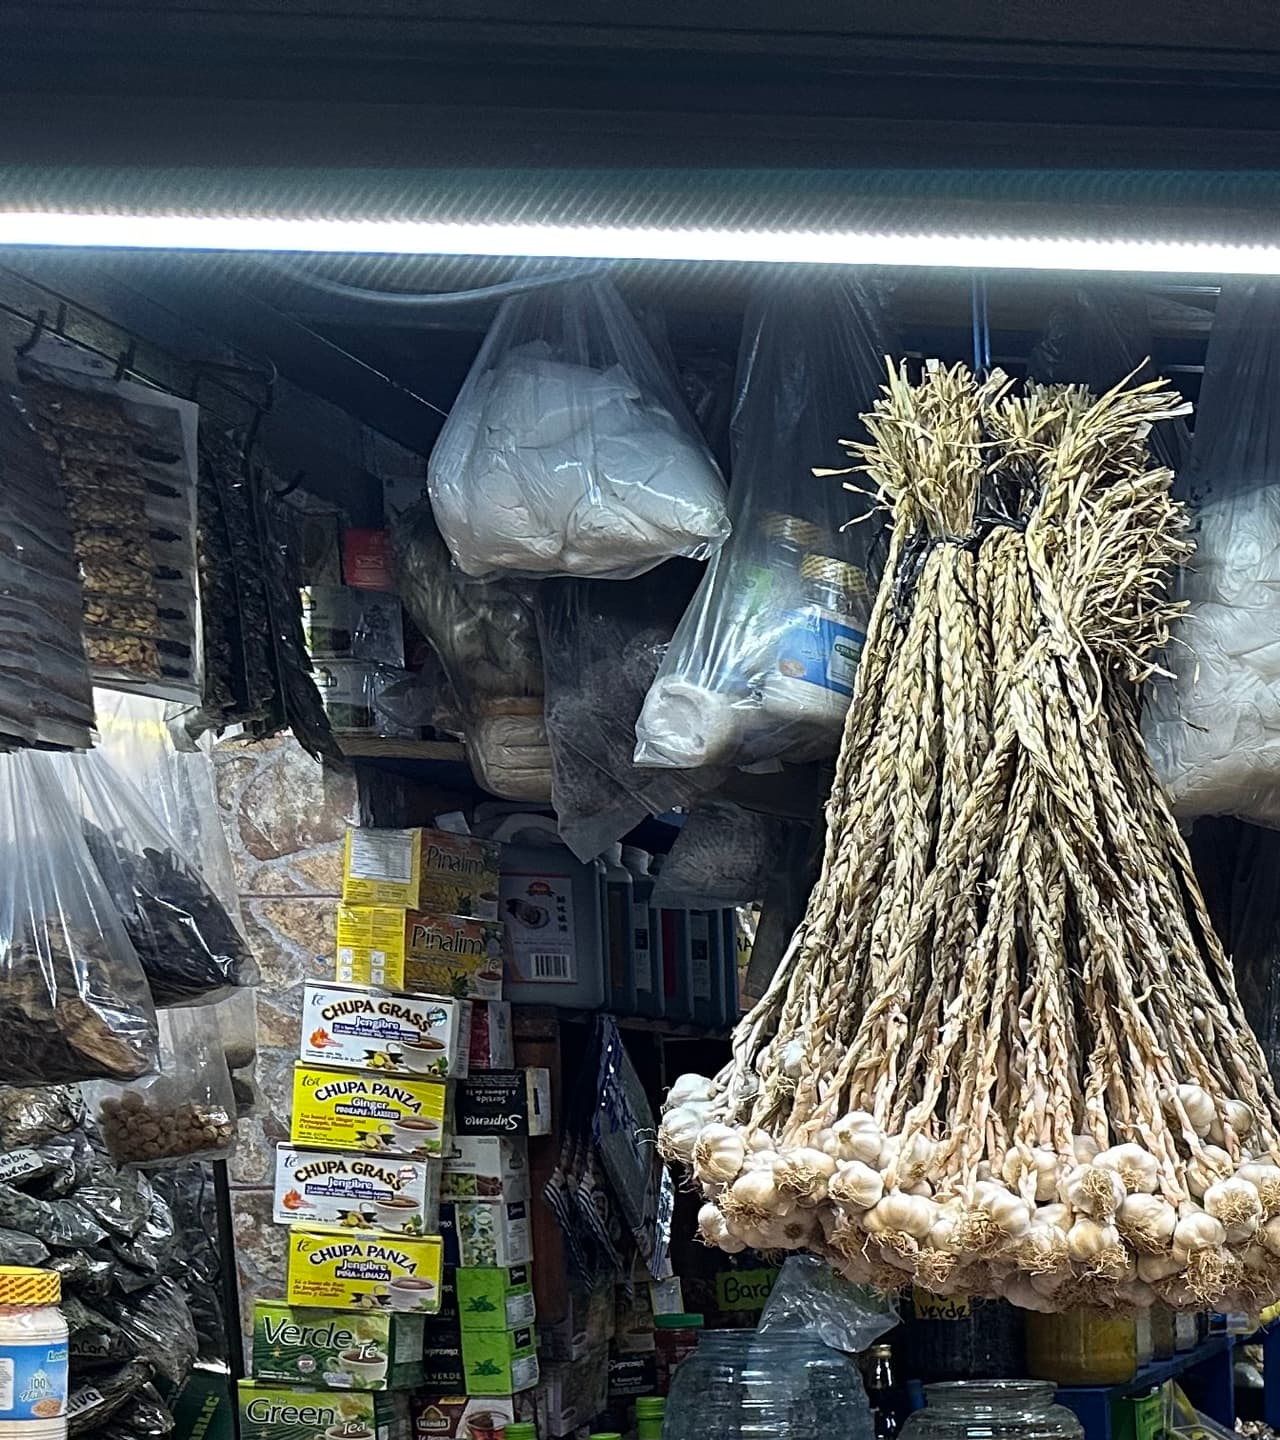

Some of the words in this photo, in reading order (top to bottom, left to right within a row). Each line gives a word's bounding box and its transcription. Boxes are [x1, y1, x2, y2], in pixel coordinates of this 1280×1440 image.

[321, 1000, 375, 1021] CHUPA
[378, 1002, 432, 1033] GRASS
[315, 1082, 368, 1101] CHUPA
[372, 1083, 422, 1114] PANZA
[352, 1097, 389, 1110] Ginger
[294, 1161, 348, 1182] CHUPA
[351, 1162, 401, 1191] GRASS
[328, 1177, 373, 1189] Jengibre
[310, 1245, 362, 1265] CHUPA
[366, 1246, 418, 1274] PANZA
[342, 1259, 387, 1272] Jengibre
[724, 1275, 771, 1302] Bard
[264, 1316, 352, 1350] Verde
[358, 1342, 377, 1360] Té
[246, 1398, 336, 1426] Green
